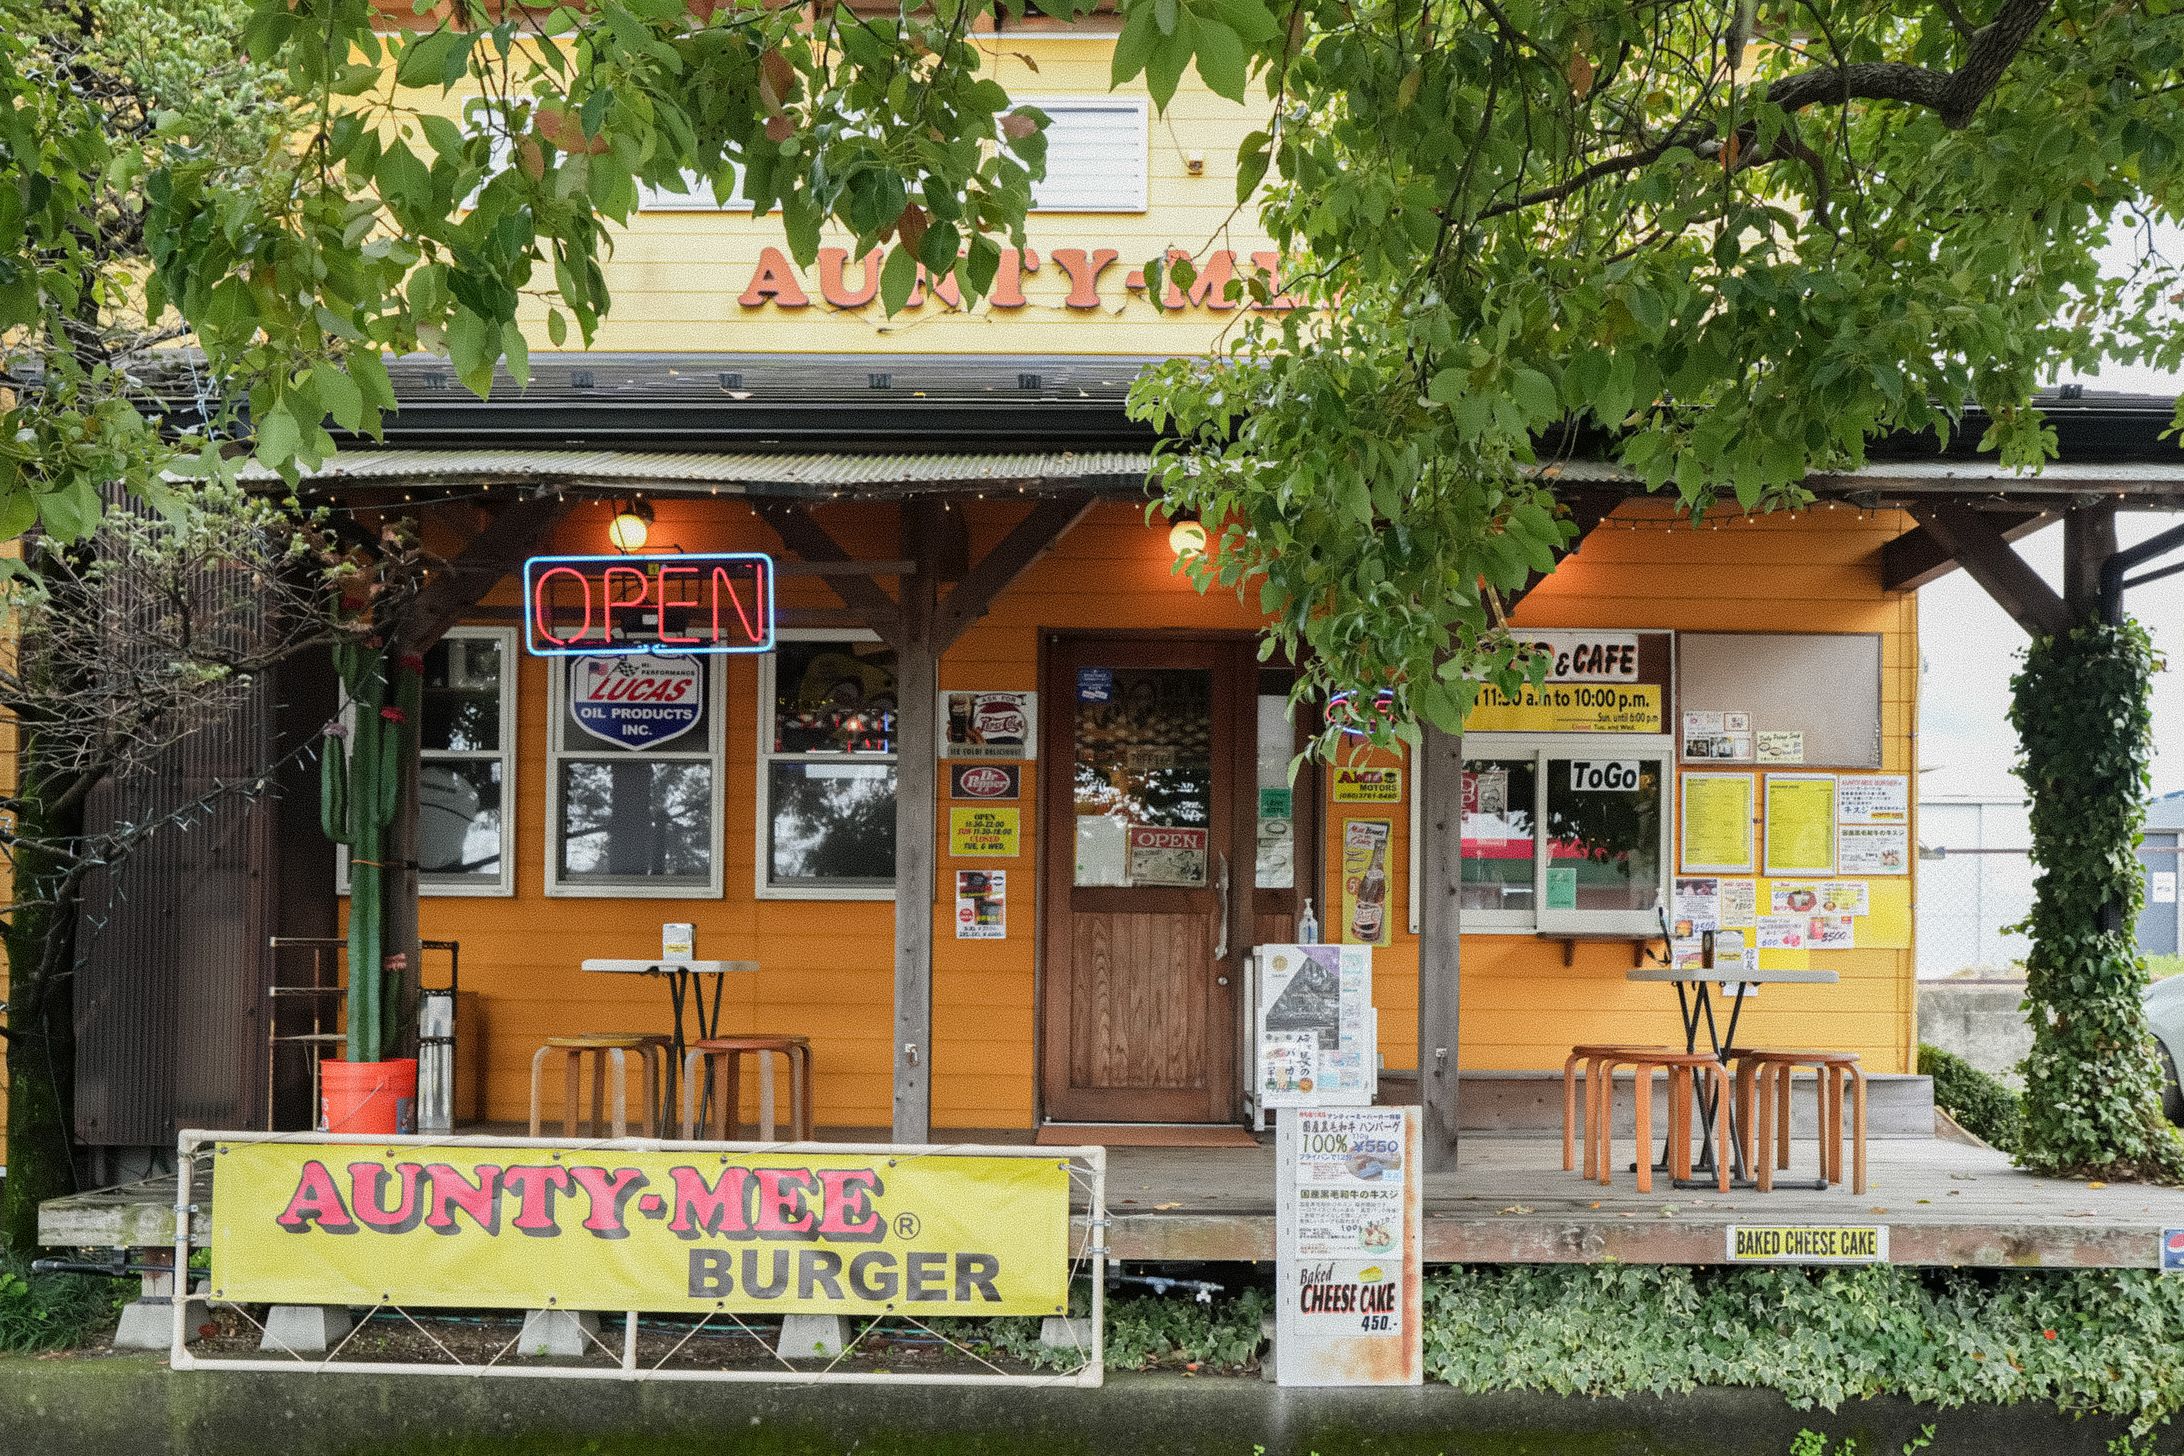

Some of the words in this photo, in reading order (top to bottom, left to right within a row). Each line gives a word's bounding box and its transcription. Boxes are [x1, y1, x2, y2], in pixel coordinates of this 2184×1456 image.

[535, 564, 763, 646] OPEN
[1555, 652, 1570, 677] &
[1573, 643, 1636, 674] CAFE
[588, 677, 693, 702] LUCAS
[1556, 690, 1570, 707] to
[1574, 688, 1616, 708] 10:00
[1619, 693, 1650, 712] p.m.
[580, 708, 606, 719] OIL
[611, 708, 693, 720] PRODUCTS
[622, 724, 652, 736] INC.
[966, 775, 1007, 793] Pepper
[980, 769, 999, 782] Dr
[1574, 761, 1637, 790] ToGo
[1359, 783, 1397, 792] MOTORS
[974, 813, 997, 821] OPEN
[969, 835, 1000, 843] CLOSED
[1137, 832, 1198, 849] OPEN
[1359, 1120, 1401, 1133] ハンバーグ
[1303, 1133, 1349, 1154] 100%
[1353, 1140, 1399, 1153] ¥550
[275, 1159, 888, 1244] AUNTY-MEE
[1736, 1230, 1781, 1255] BAKED
[1785, 1230, 1836, 1256] CHEESE
[1840, 1230, 1876, 1256] CAKE
[688, 1248, 1003, 1302] BURGER
[1300, 1262, 1336, 1287] Baked
[1300, 1283, 1358, 1315] CHEESE
[1359, 1282, 1397, 1314] CAKE
